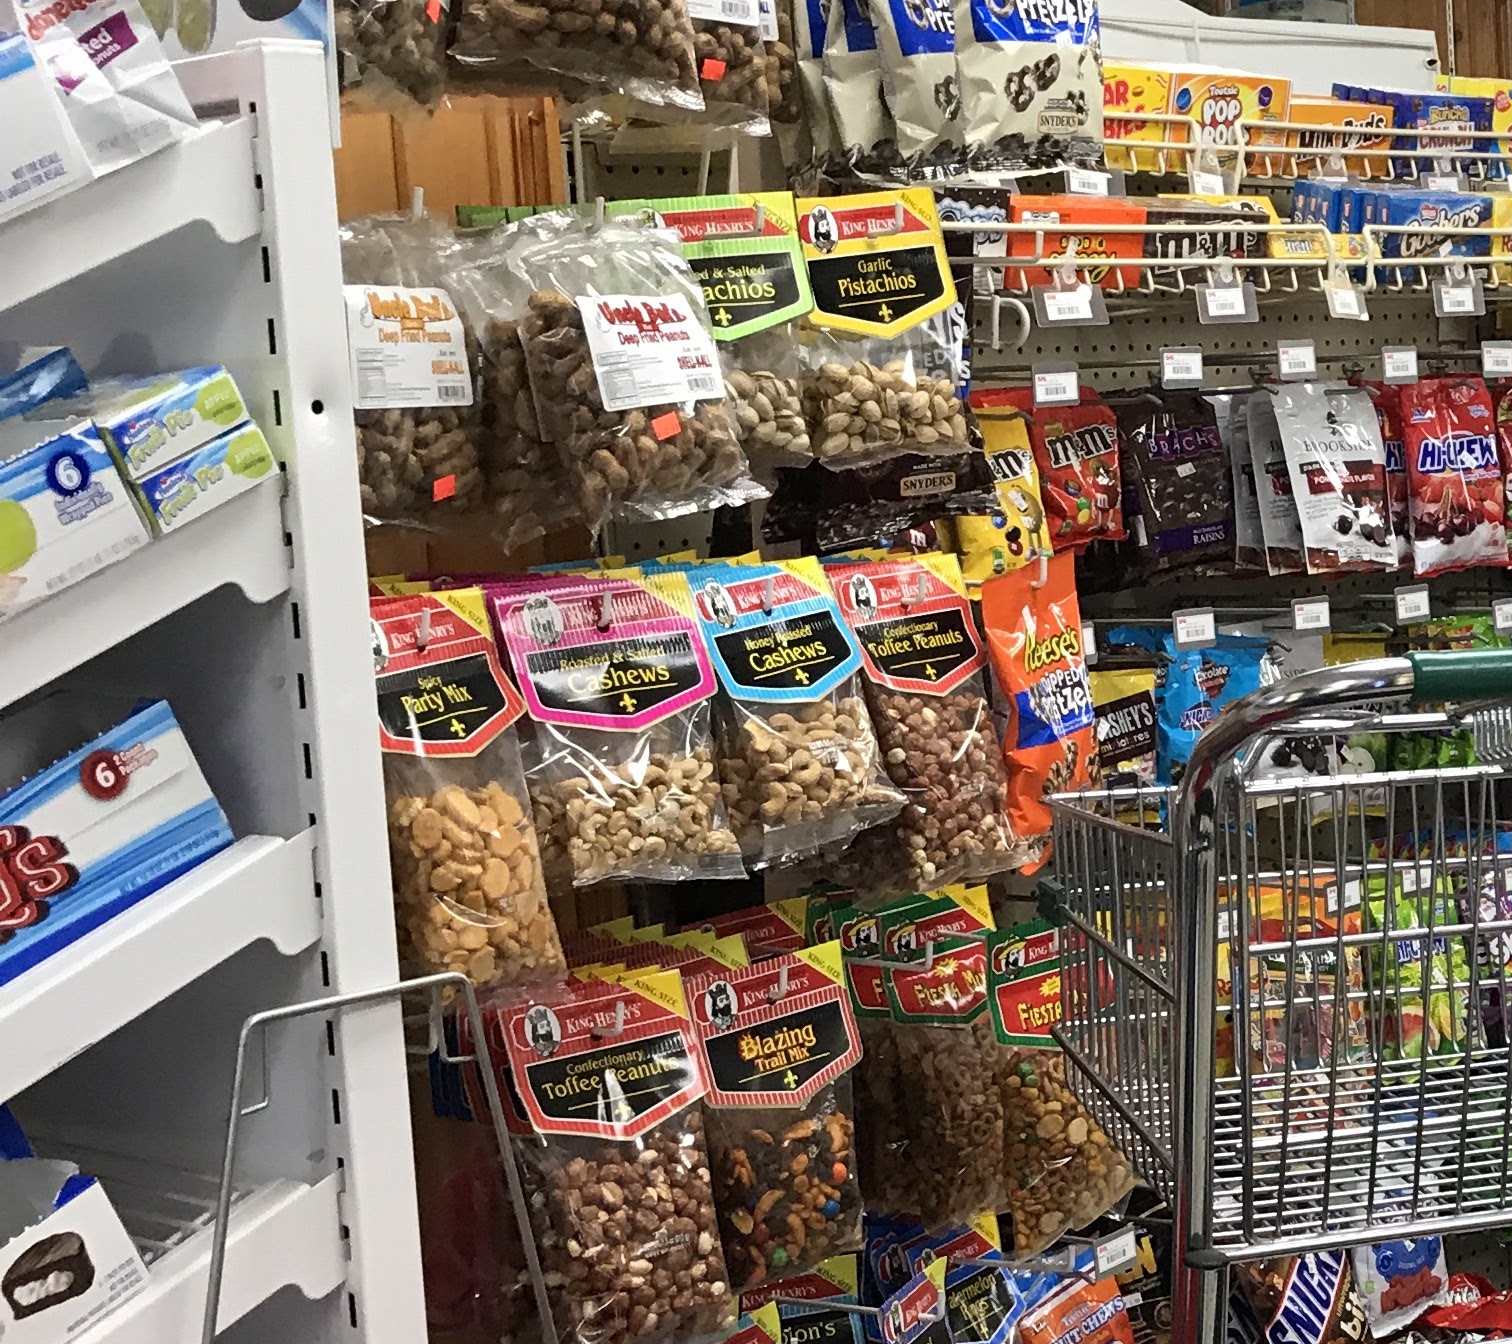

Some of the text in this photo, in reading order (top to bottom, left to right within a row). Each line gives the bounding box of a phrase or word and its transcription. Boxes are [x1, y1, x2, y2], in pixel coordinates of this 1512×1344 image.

[1209, 84, 1240, 97] Tootsie
[1039, 114, 1077, 128] SNYDER'S
[1202, 98, 1242, 126] POP
[1429, 105, 1470, 124] Buncha
[674, 220, 755, 240] KING HENRY'S
[842, 220, 867, 237] KING
[725, 264, 767, 279] Salted
[857, 256, 893, 275] Garlic
[703, 277, 776, 302] achios
[837, 271, 917, 298] Pistachios
[379, 327, 400, 344] Deep
[618, 331, 639, 346] Deep
[54, 455, 82, 491] 6
[902, 475, 954, 492] SNYDER'S
[1192, 529, 1226, 545] RAISINS
[416, 622, 455, 642] HNRY'S
[744, 624, 813, 652] Honey Roasted
[883, 620, 939, 638] Confectionary
[868, 629, 964, 659] Toffee Peanuts
[1024, 627, 1080, 672] Reese's
[559, 650, 611, 671] Roasted
[749, 639, 828, 672] Cashews
[418, 675, 443, 690] Spicy
[567, 663, 671, 695] Cashews
[401, 684, 473, 716] Party Mix
[95, 762, 117, 788] 6
[1028, 944, 1048, 960] KING
[633, 978, 678, 1008] KING SIZE
[742, 990, 769, 1007] KING
[565, 1015, 594, 1034] KING
[739, 1022, 818, 1061] Blazing
[566, 1048, 644, 1075] Confectionary
[754, 1046, 811, 1073] Trail Mix
[541, 1073, 601, 1100] Toffee
[1081, 1294, 1127, 1335] CHEWS
